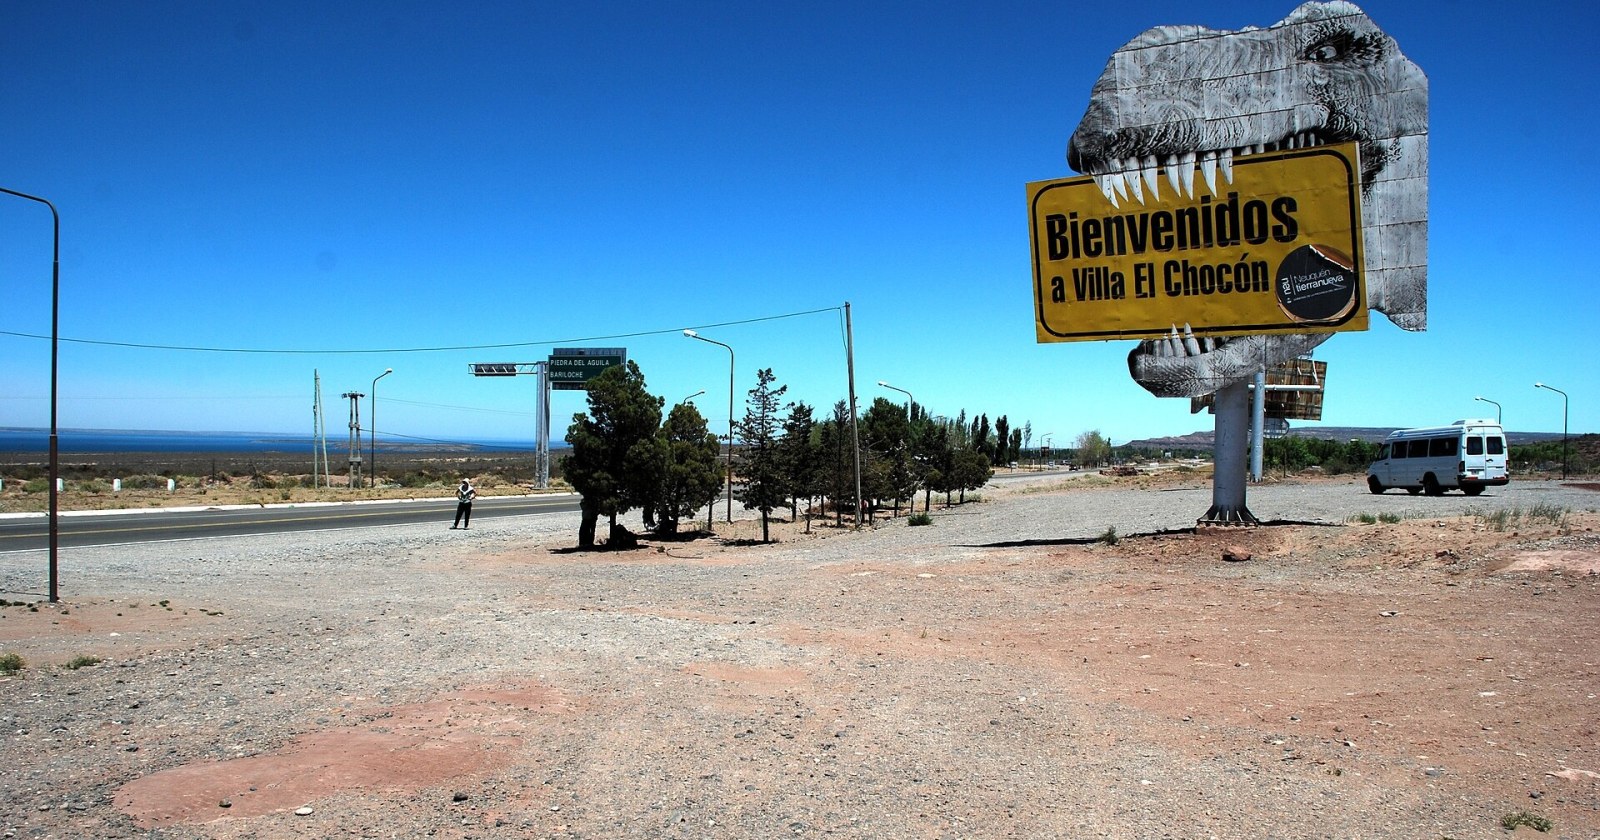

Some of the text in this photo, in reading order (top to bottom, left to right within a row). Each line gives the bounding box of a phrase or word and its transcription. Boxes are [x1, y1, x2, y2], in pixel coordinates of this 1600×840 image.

[1046, 191, 1298, 261] Bienvenidos
[1051, 253, 1270, 303] a Villa El Chocón
[1294, 269, 1331, 284] Neuquén
[1296, 274, 1344, 292] tierranueva
